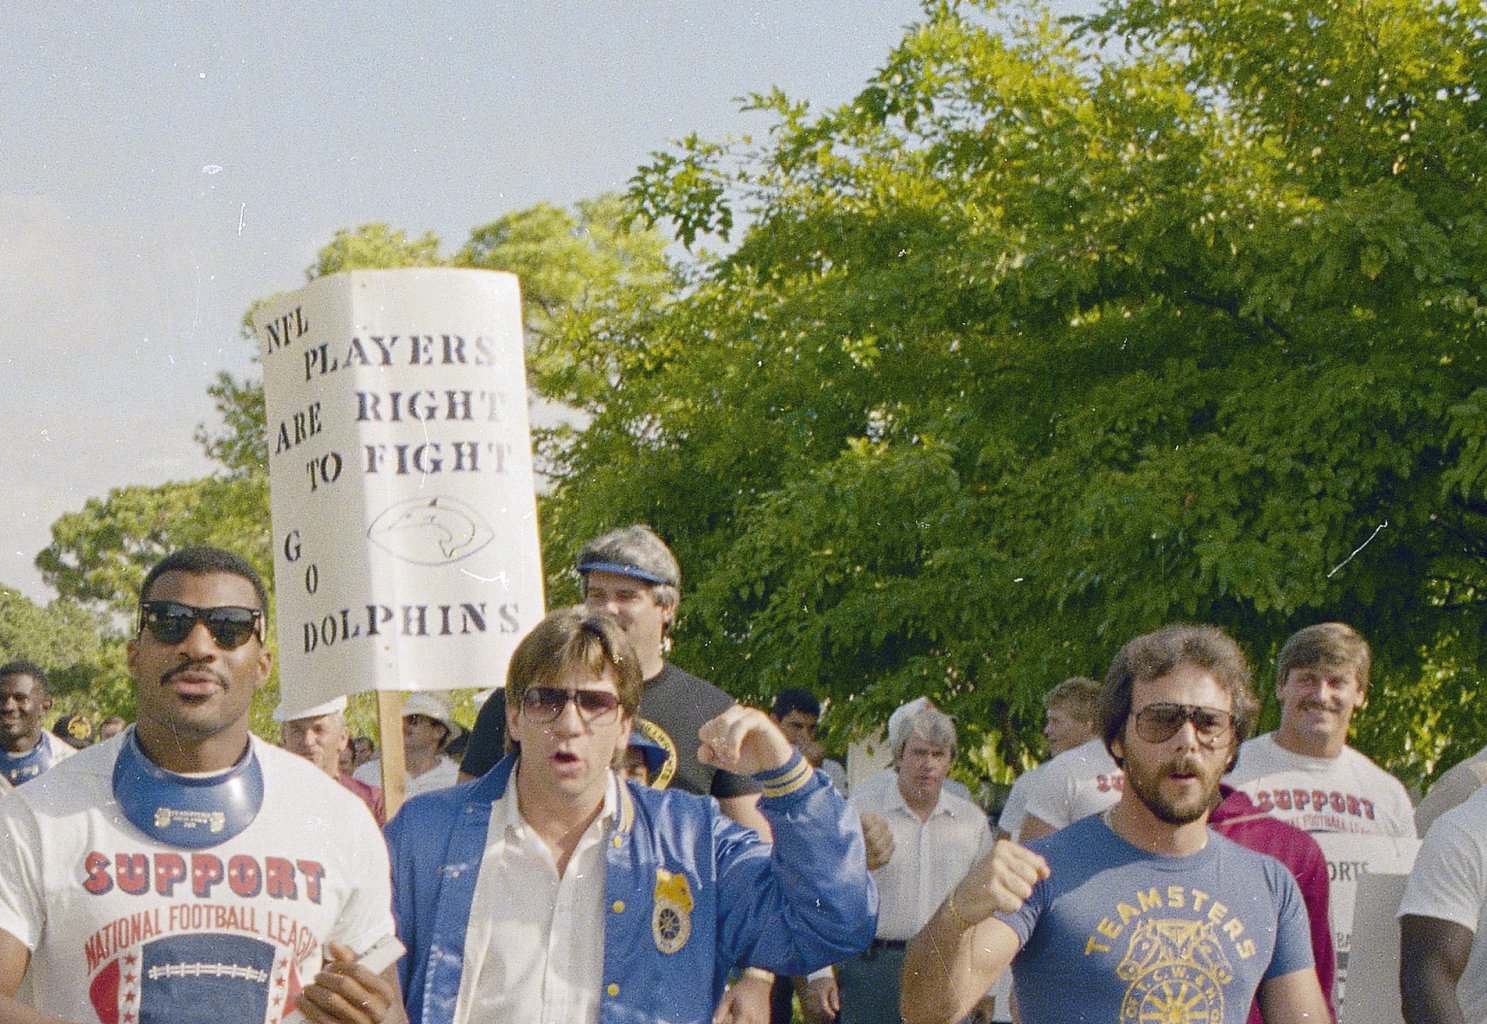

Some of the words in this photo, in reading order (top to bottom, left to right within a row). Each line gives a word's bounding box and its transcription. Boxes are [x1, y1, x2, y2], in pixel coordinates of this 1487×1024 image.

[266, 306, 308, 354] NFL
[305, 334, 495, 382] PLAYERS
[276, 403, 321, 455] ARE
[356, 390, 507, 423] RIGHT
[306, 452, 342, 492] TO
[366, 441, 511, 475] FIGHT
[304, 602, 521, 653] DOLPHINS
[1256, 789, 1375, 820] SUPPORT
[83, 851, 326, 904] SUPPORT
[84, 908, 162, 976] NATIONAL
[169, 903, 259, 933] FOOTBALL
[1084, 886, 1256, 960] TEAMSTERS
